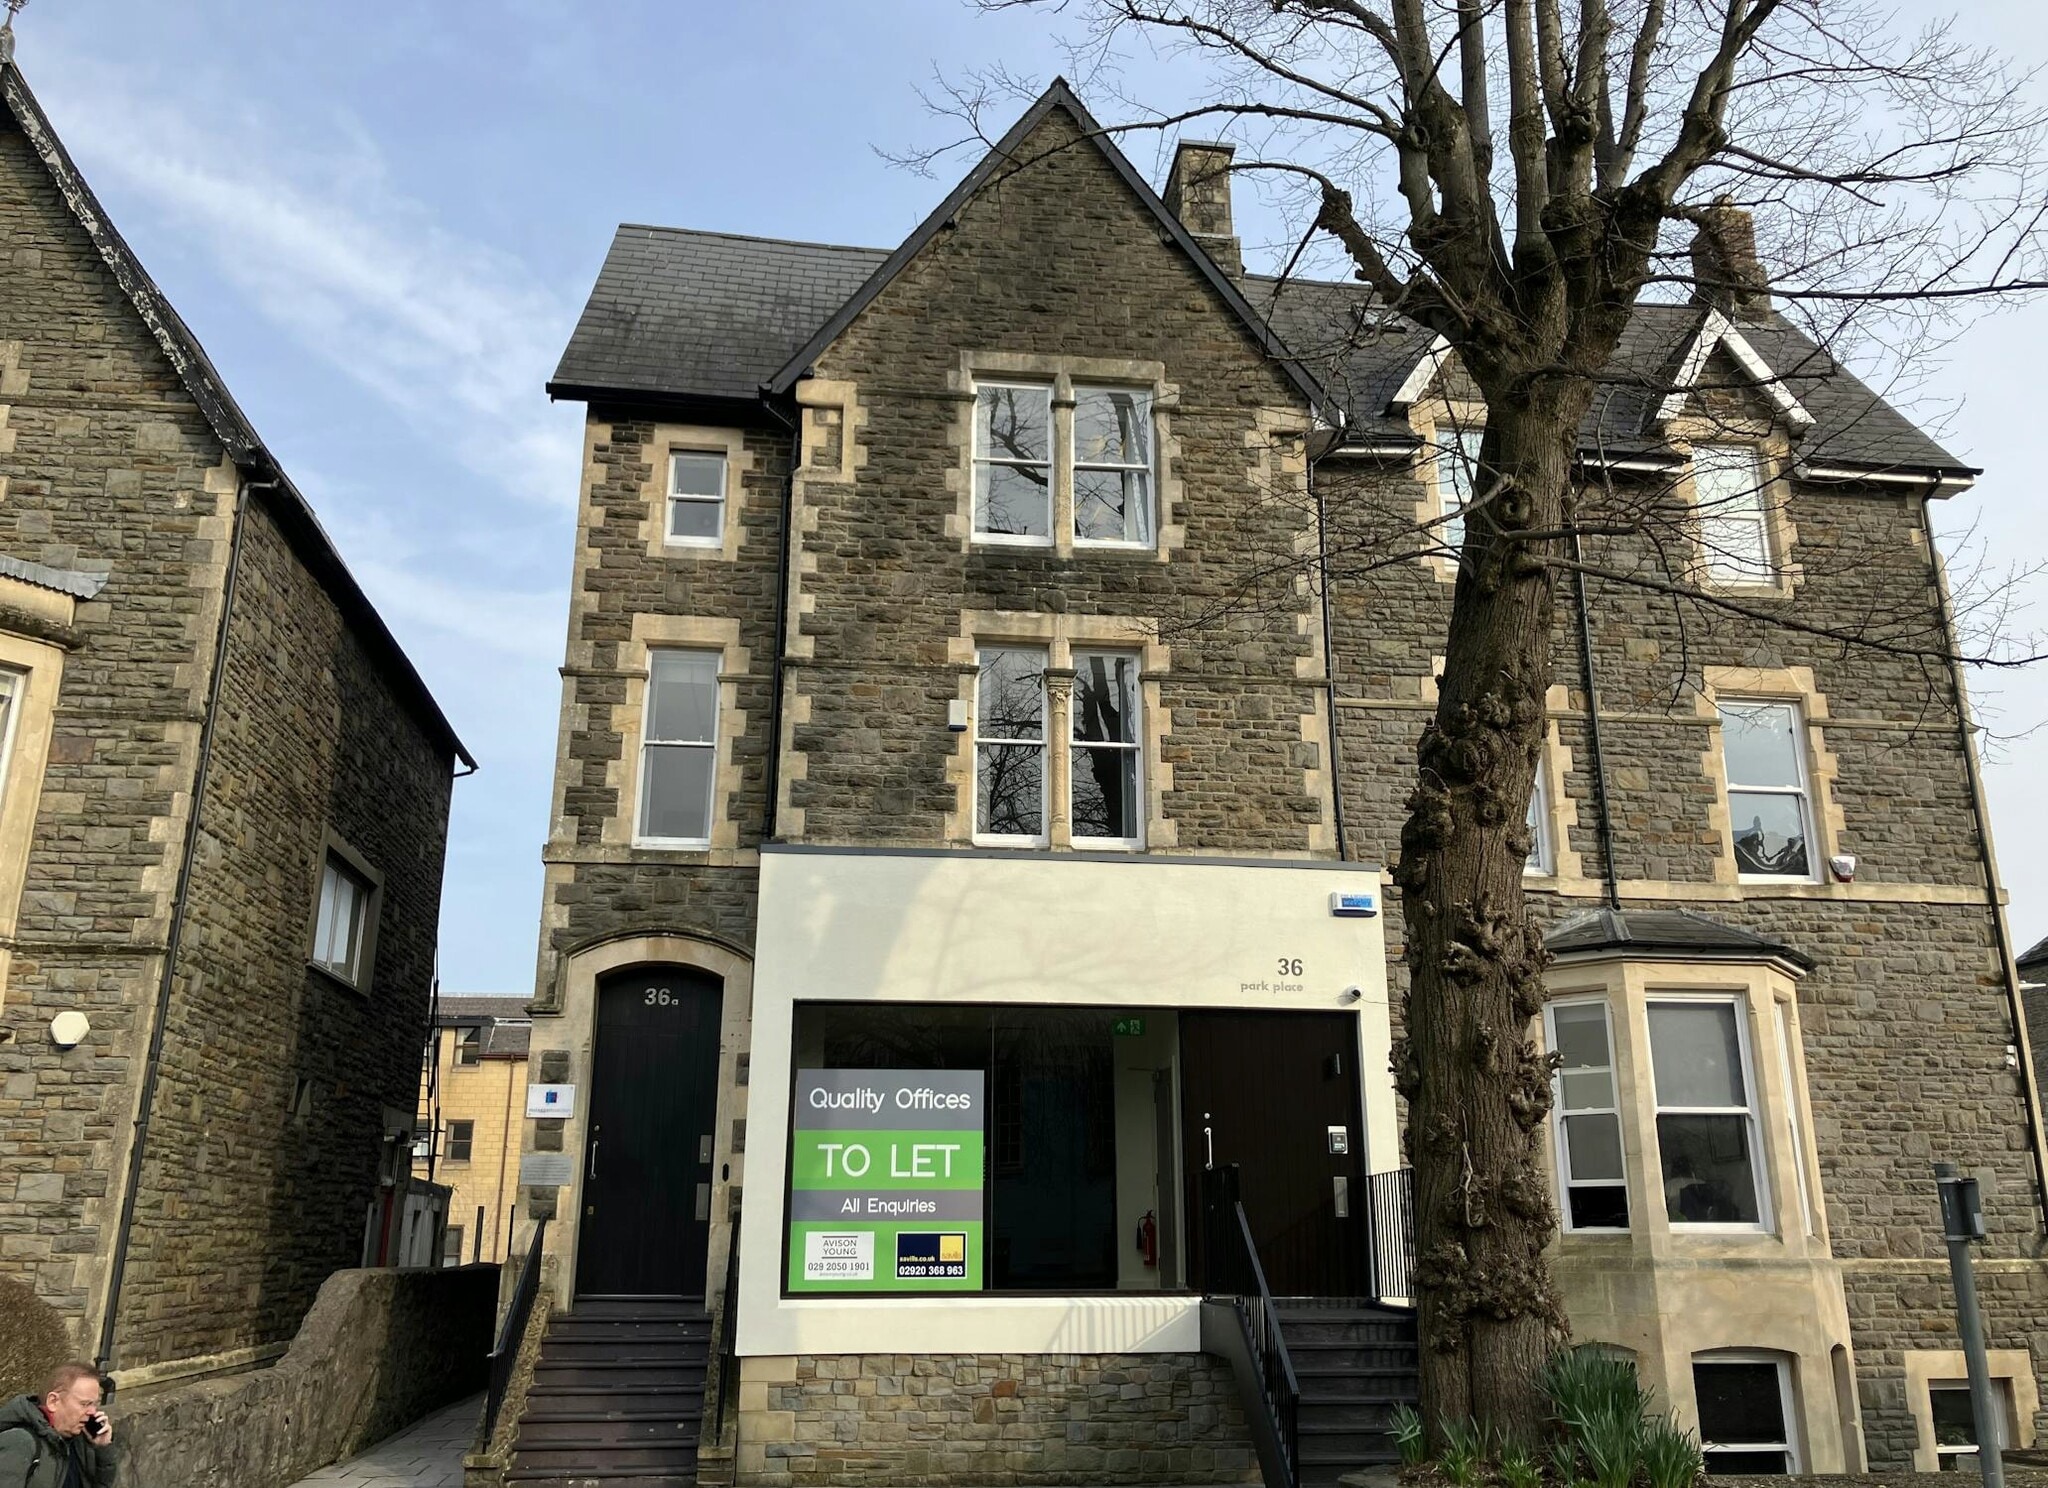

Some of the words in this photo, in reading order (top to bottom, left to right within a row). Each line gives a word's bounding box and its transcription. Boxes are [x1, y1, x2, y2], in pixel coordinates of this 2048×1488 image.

[1277, 958, 1303, 976] 36
[1240, 980, 1269, 992] park
[1273, 980, 1304, 994] place
[809, 1087, 885, 1113] Quality
[895, 1087, 971, 1110] Offices
[817, 1143, 871, 1178] TO
[890, 1143, 961, 1178] LET
[841, 1198, 860, 1213] All
[867, 1198, 937, 1216] Enquiries
[822, 1239, 857, 1247] AVISON
[822, 1248, 857, 1256] YOUNG
[808, 1262, 824, 1271] 029
[826, 1262, 848, 1271] 2050
[850, 1261, 870, 1271] 1901
[899, 1265, 927, 1276] 02920
[928, 1265, 945, 1276] 368
[946, 1265, 964, 1276] 963
